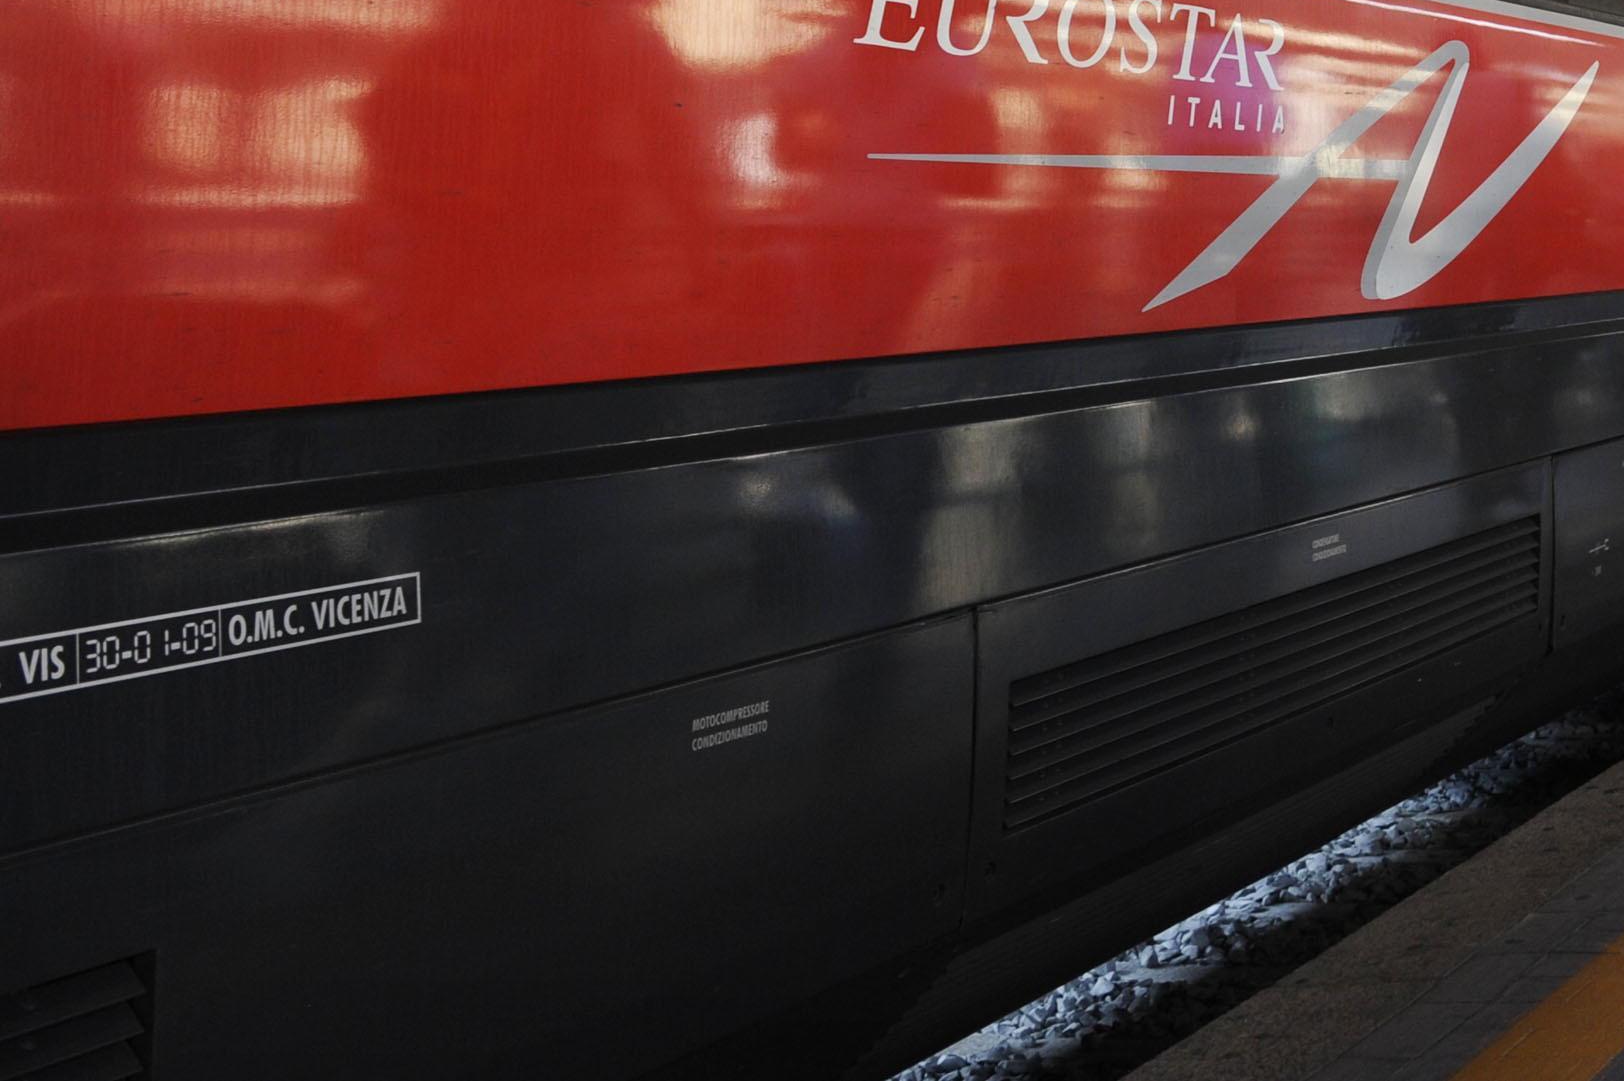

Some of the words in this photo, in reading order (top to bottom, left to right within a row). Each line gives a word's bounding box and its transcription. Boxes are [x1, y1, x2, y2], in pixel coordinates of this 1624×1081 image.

[1167, 94, 1286, 134] ITALIA
[18, 645, 65, 685] VIS
[228, 604, 305, 646] O.M.C.
[311, 586, 407, 630] VICENZA
[692, 701, 769, 731] MOTOCOMPRESSORE
[692, 720, 768, 751] CONDIZIONAMENTO
